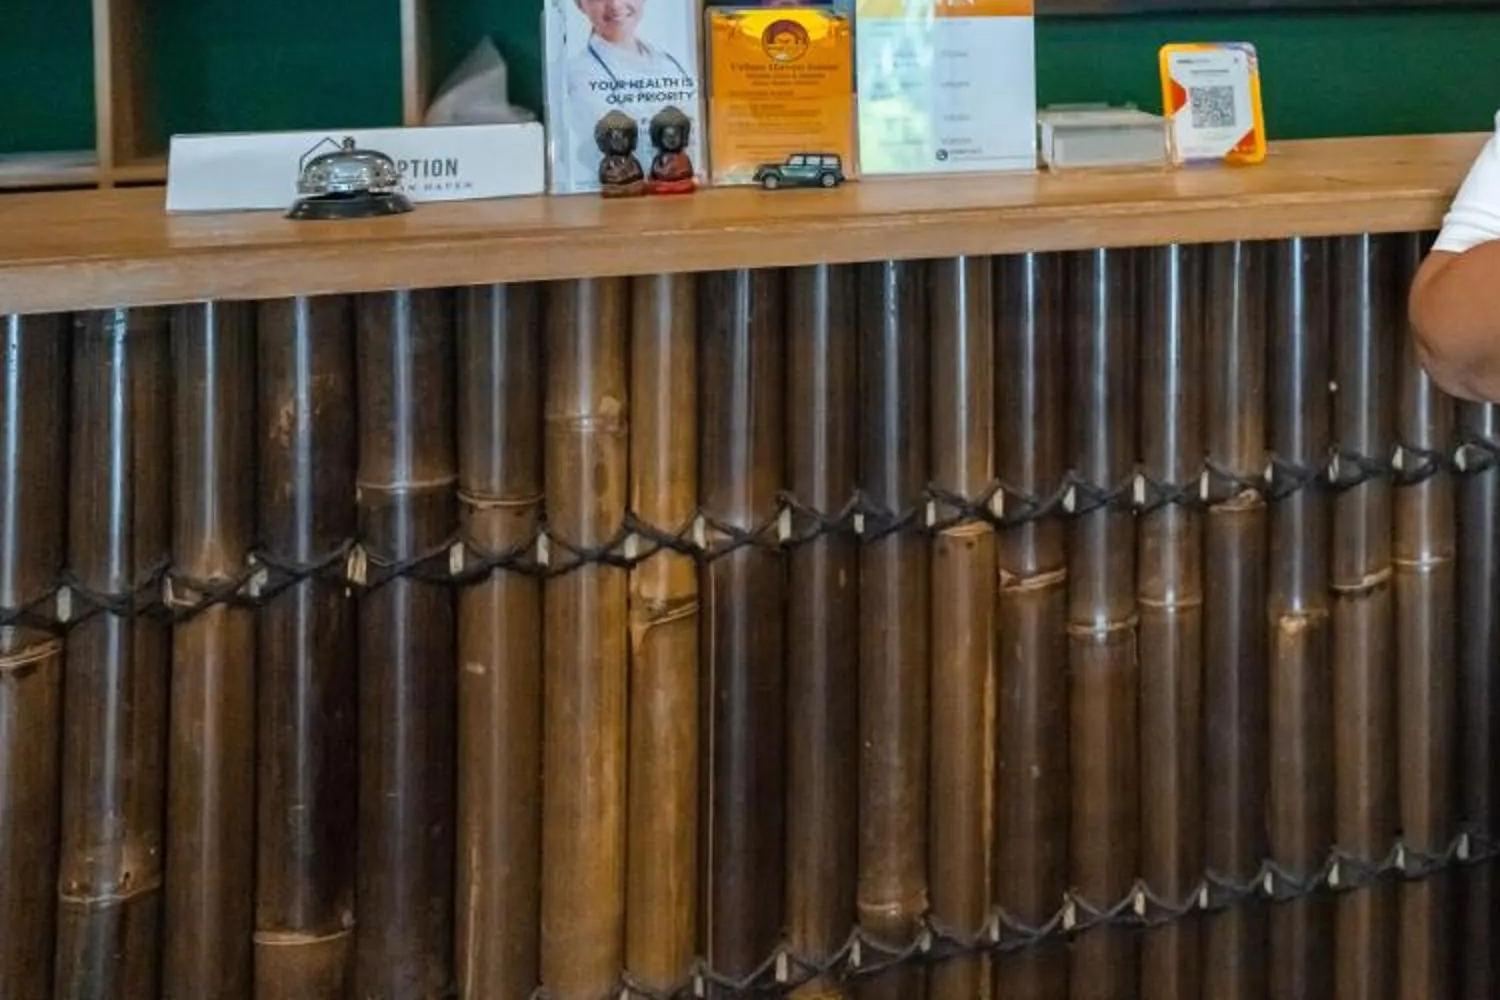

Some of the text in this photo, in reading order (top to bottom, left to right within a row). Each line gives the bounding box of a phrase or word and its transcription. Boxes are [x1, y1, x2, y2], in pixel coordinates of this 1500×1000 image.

[588, 76, 695, 92] YOUR HEALTH IS
[605, 90, 695, 105] OUR PRIORITY
